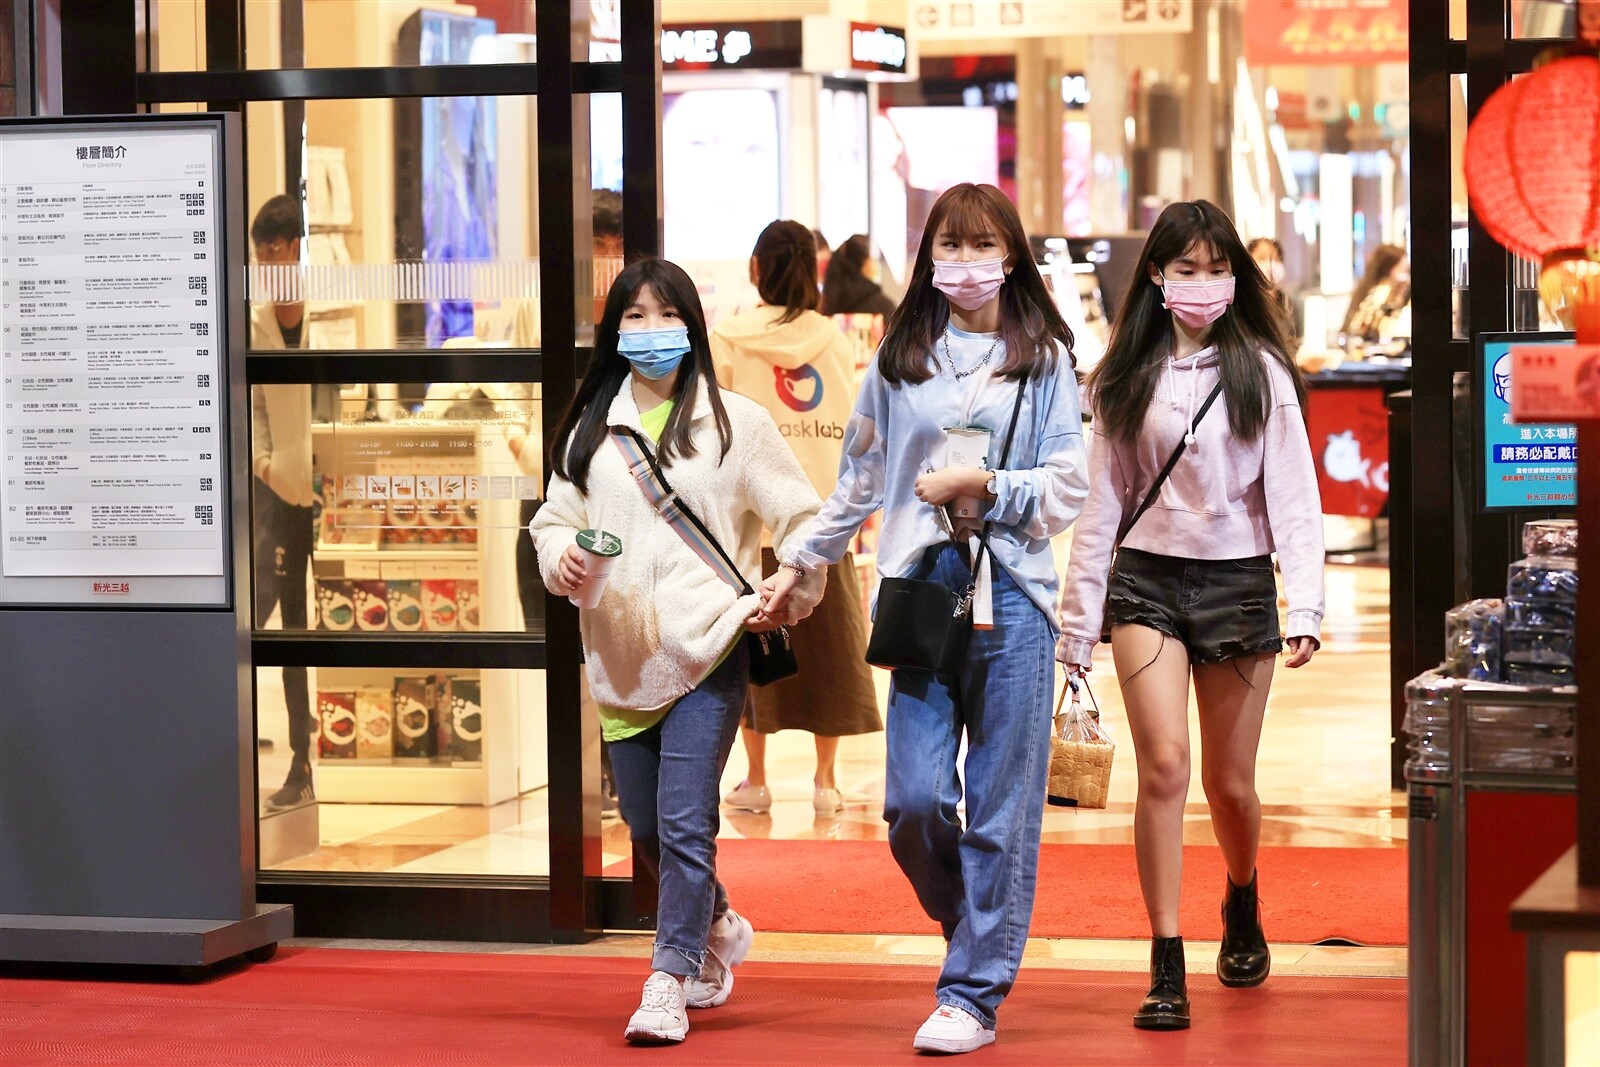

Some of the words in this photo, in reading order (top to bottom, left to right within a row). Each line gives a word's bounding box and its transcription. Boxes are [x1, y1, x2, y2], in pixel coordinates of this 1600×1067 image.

[76, 145, 127, 160] 樓層簡介
[1520, 427, 1578, 440] 進入本場所
[93, 582, 130, 593] 新光三越
